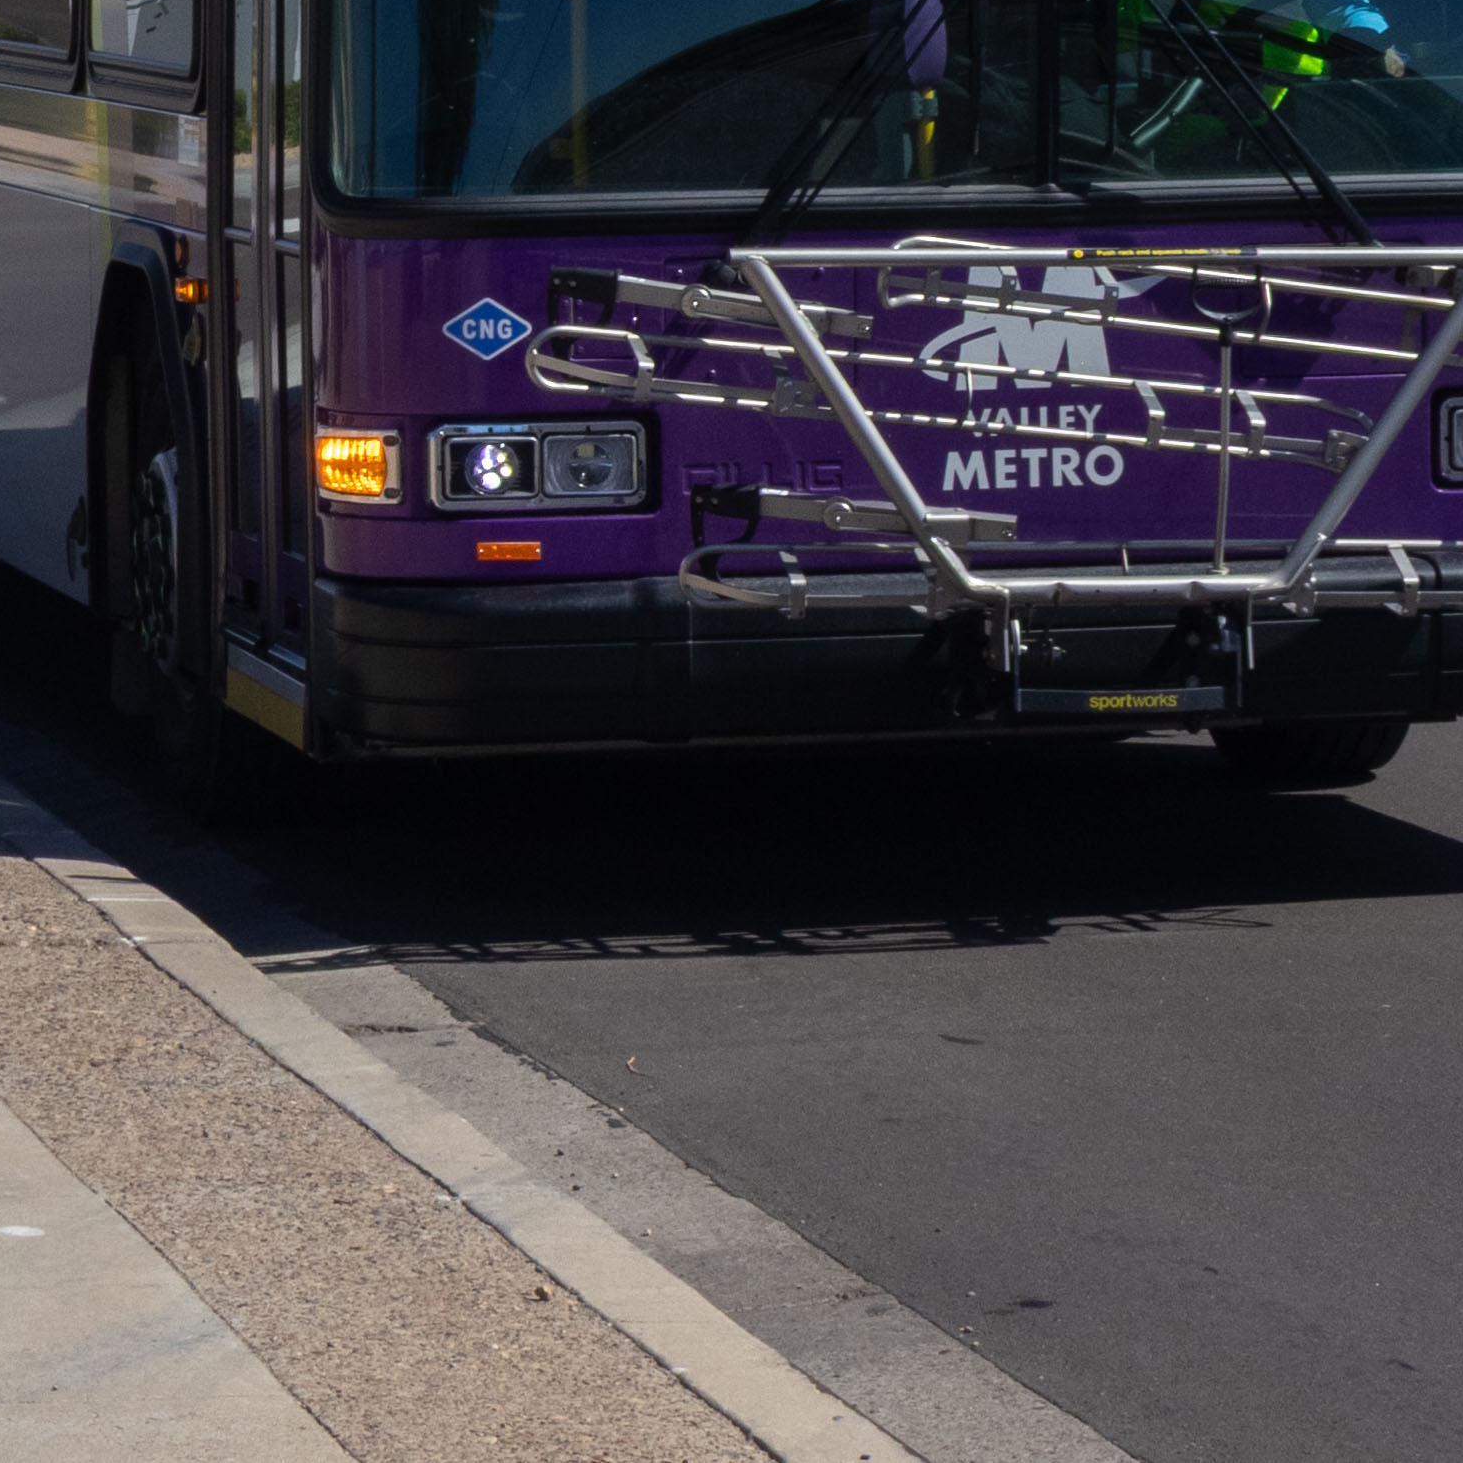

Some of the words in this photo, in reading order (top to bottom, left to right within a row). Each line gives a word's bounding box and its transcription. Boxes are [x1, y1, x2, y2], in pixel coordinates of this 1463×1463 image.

[462, 318, 513, 340] CNG
[966, 404, 1103, 437] VALLEY
[942, 444, 1124, 491] METRO
[1088, 693, 1179, 711] sportworks
